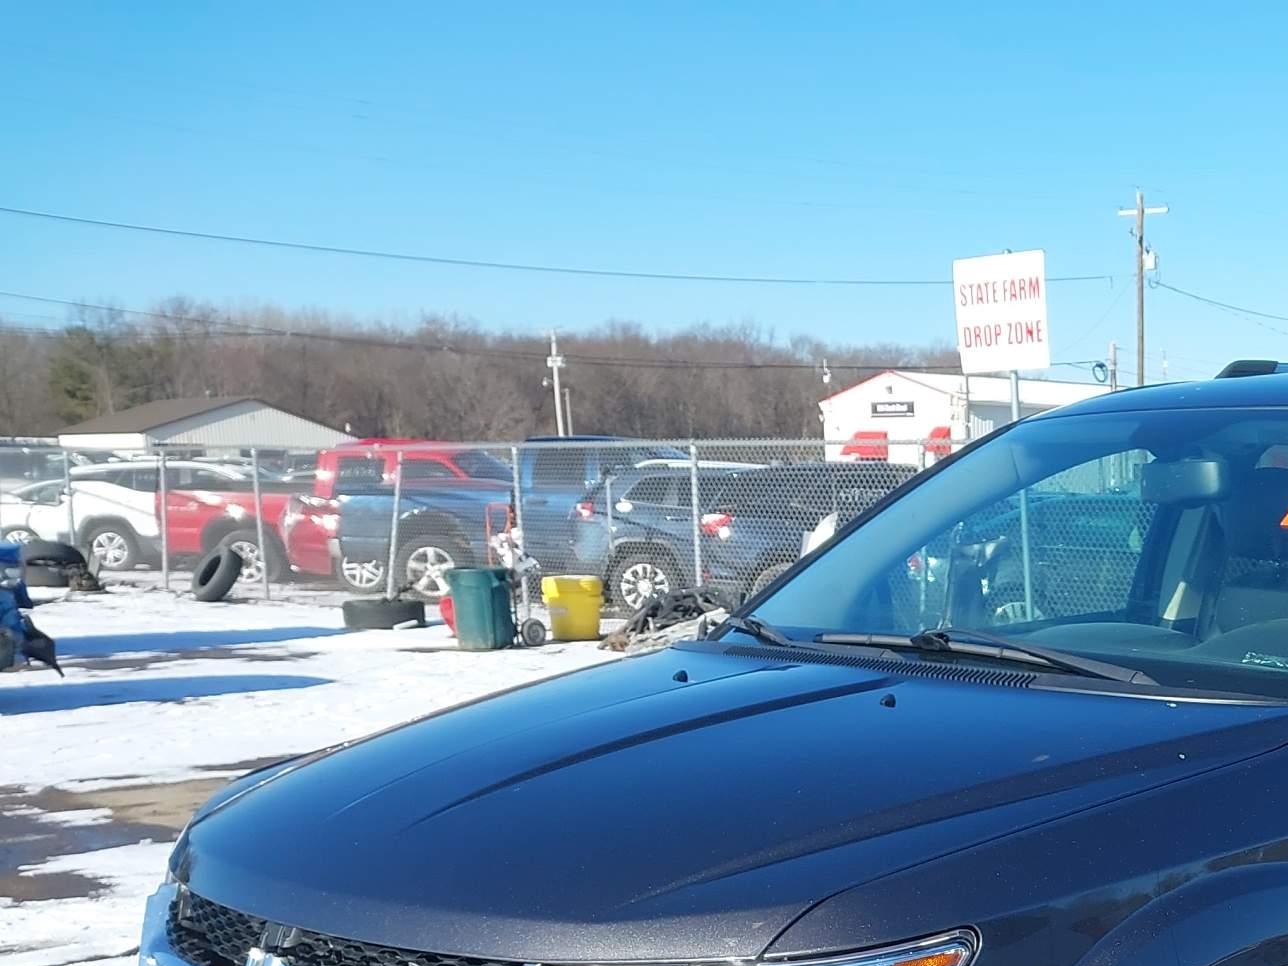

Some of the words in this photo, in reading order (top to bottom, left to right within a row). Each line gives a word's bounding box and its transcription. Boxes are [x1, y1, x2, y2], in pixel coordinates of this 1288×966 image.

[960, 281, 998, 306] STATE
[1003, 276, 1040, 302] FARM
[963, 324, 1001, 348] DROP
[1007, 320, 1043, 344] ZONE
